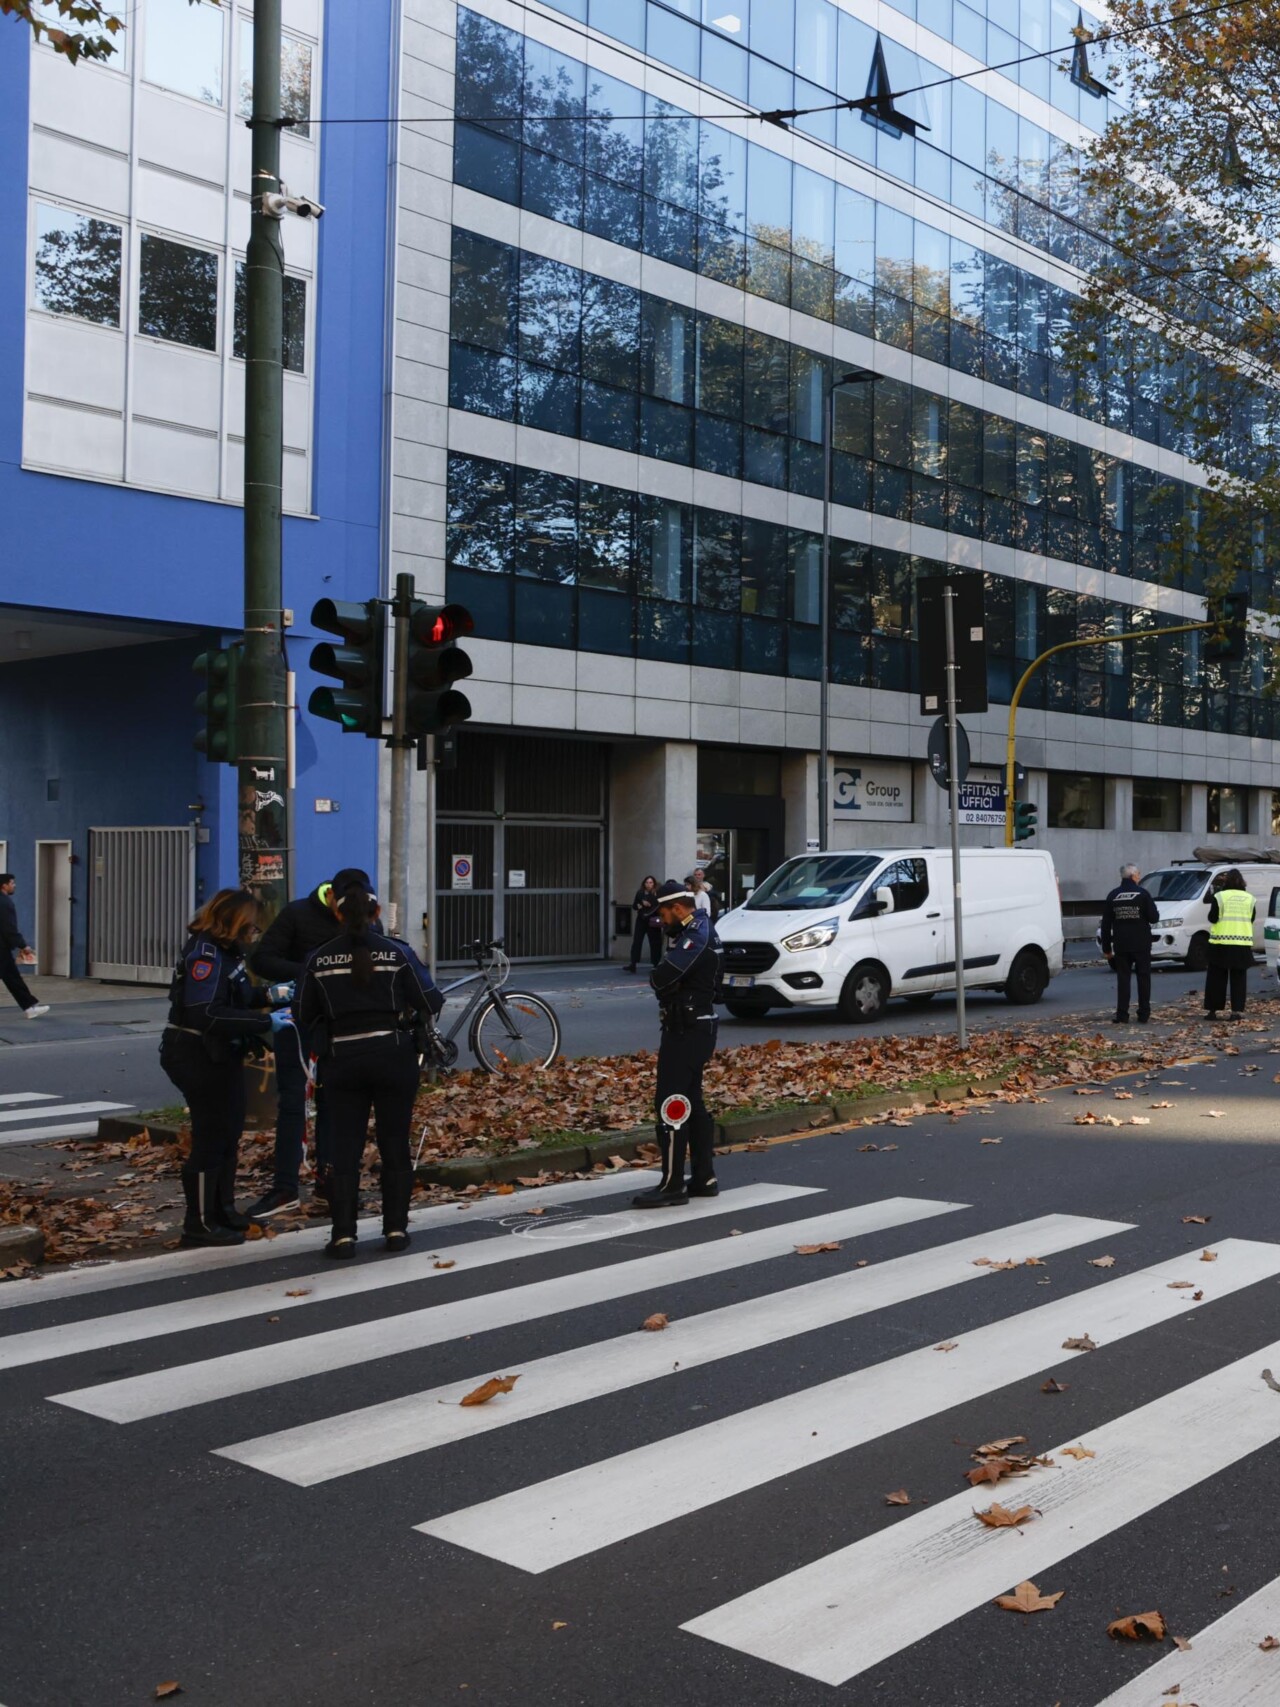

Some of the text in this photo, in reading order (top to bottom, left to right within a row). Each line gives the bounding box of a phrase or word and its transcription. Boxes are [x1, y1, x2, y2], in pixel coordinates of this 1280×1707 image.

[866, 781, 900, 801] Group
[961, 796, 993, 809] UFFICI
[965, 813, 974, 822] 02
[316, 954, 352, 966] POLIZIA
